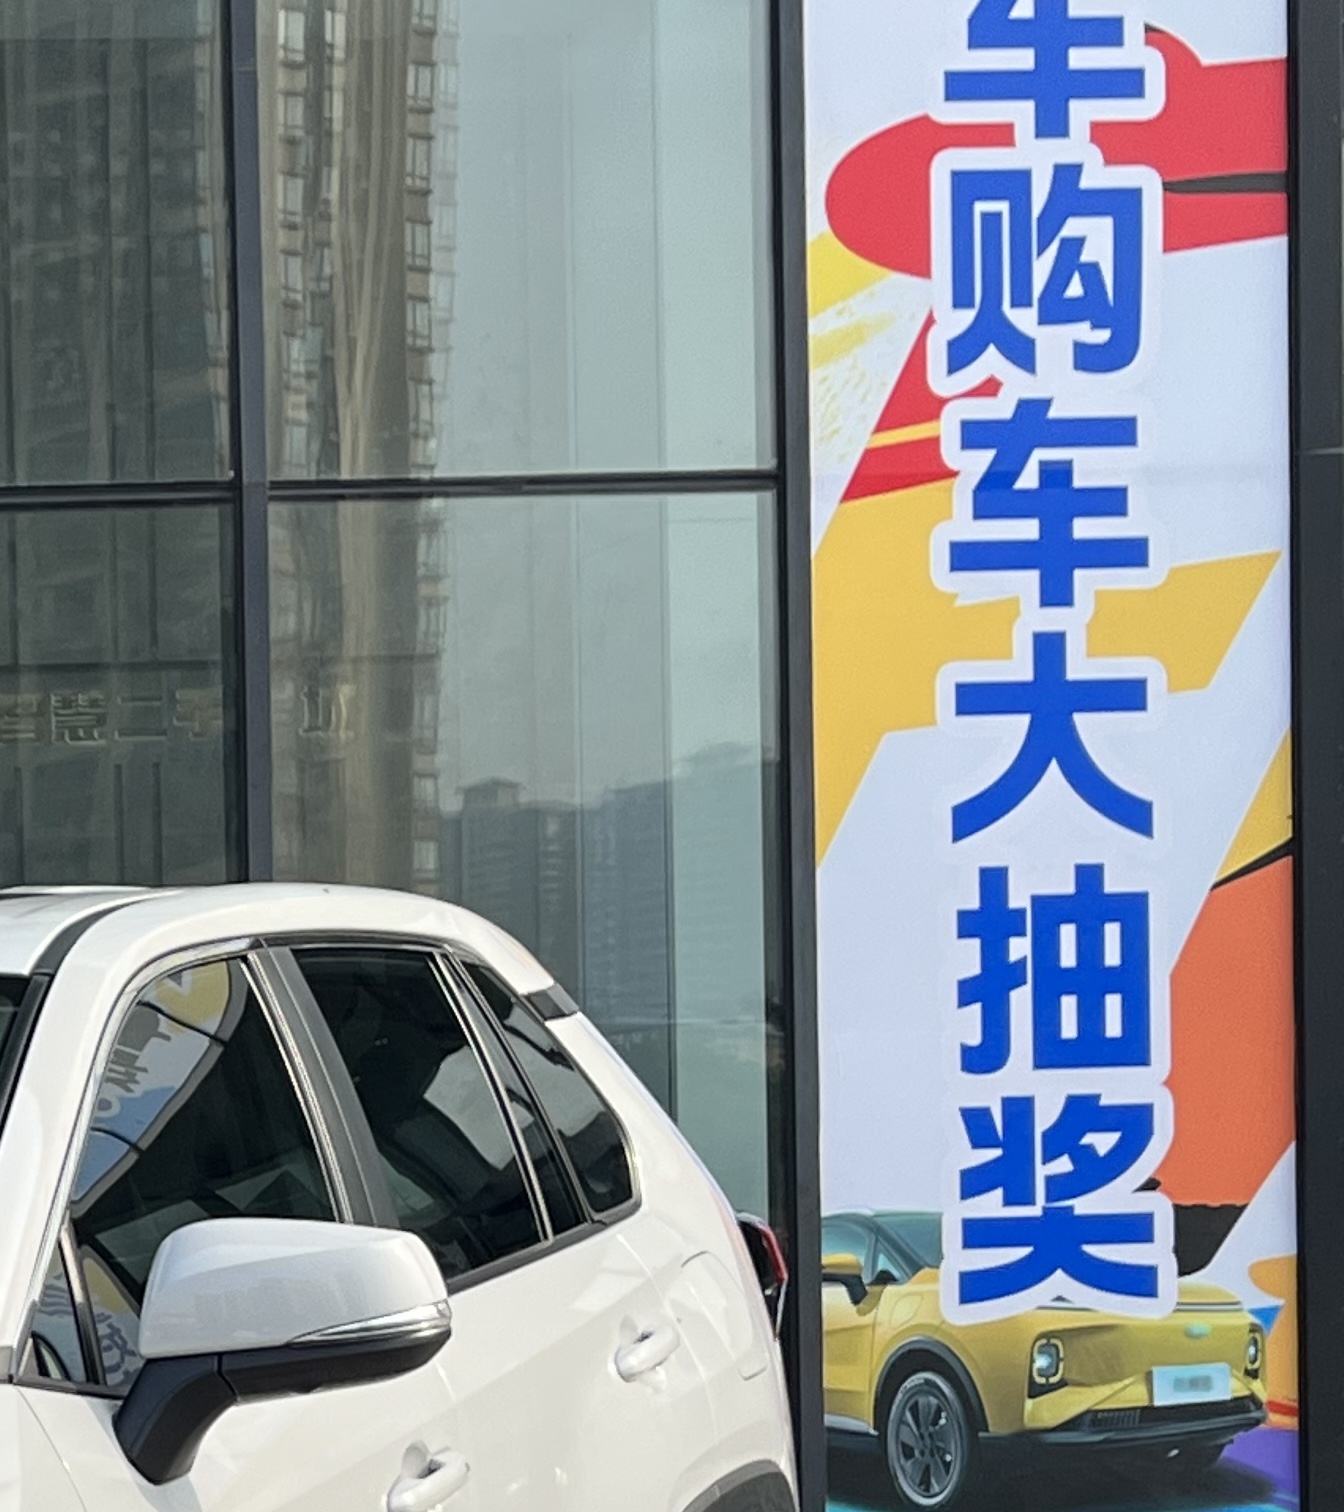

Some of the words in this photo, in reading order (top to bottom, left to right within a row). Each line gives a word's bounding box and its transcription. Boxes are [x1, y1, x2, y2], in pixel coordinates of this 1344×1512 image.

[943, 0, 1159, 1305] 车购车大抽奖
